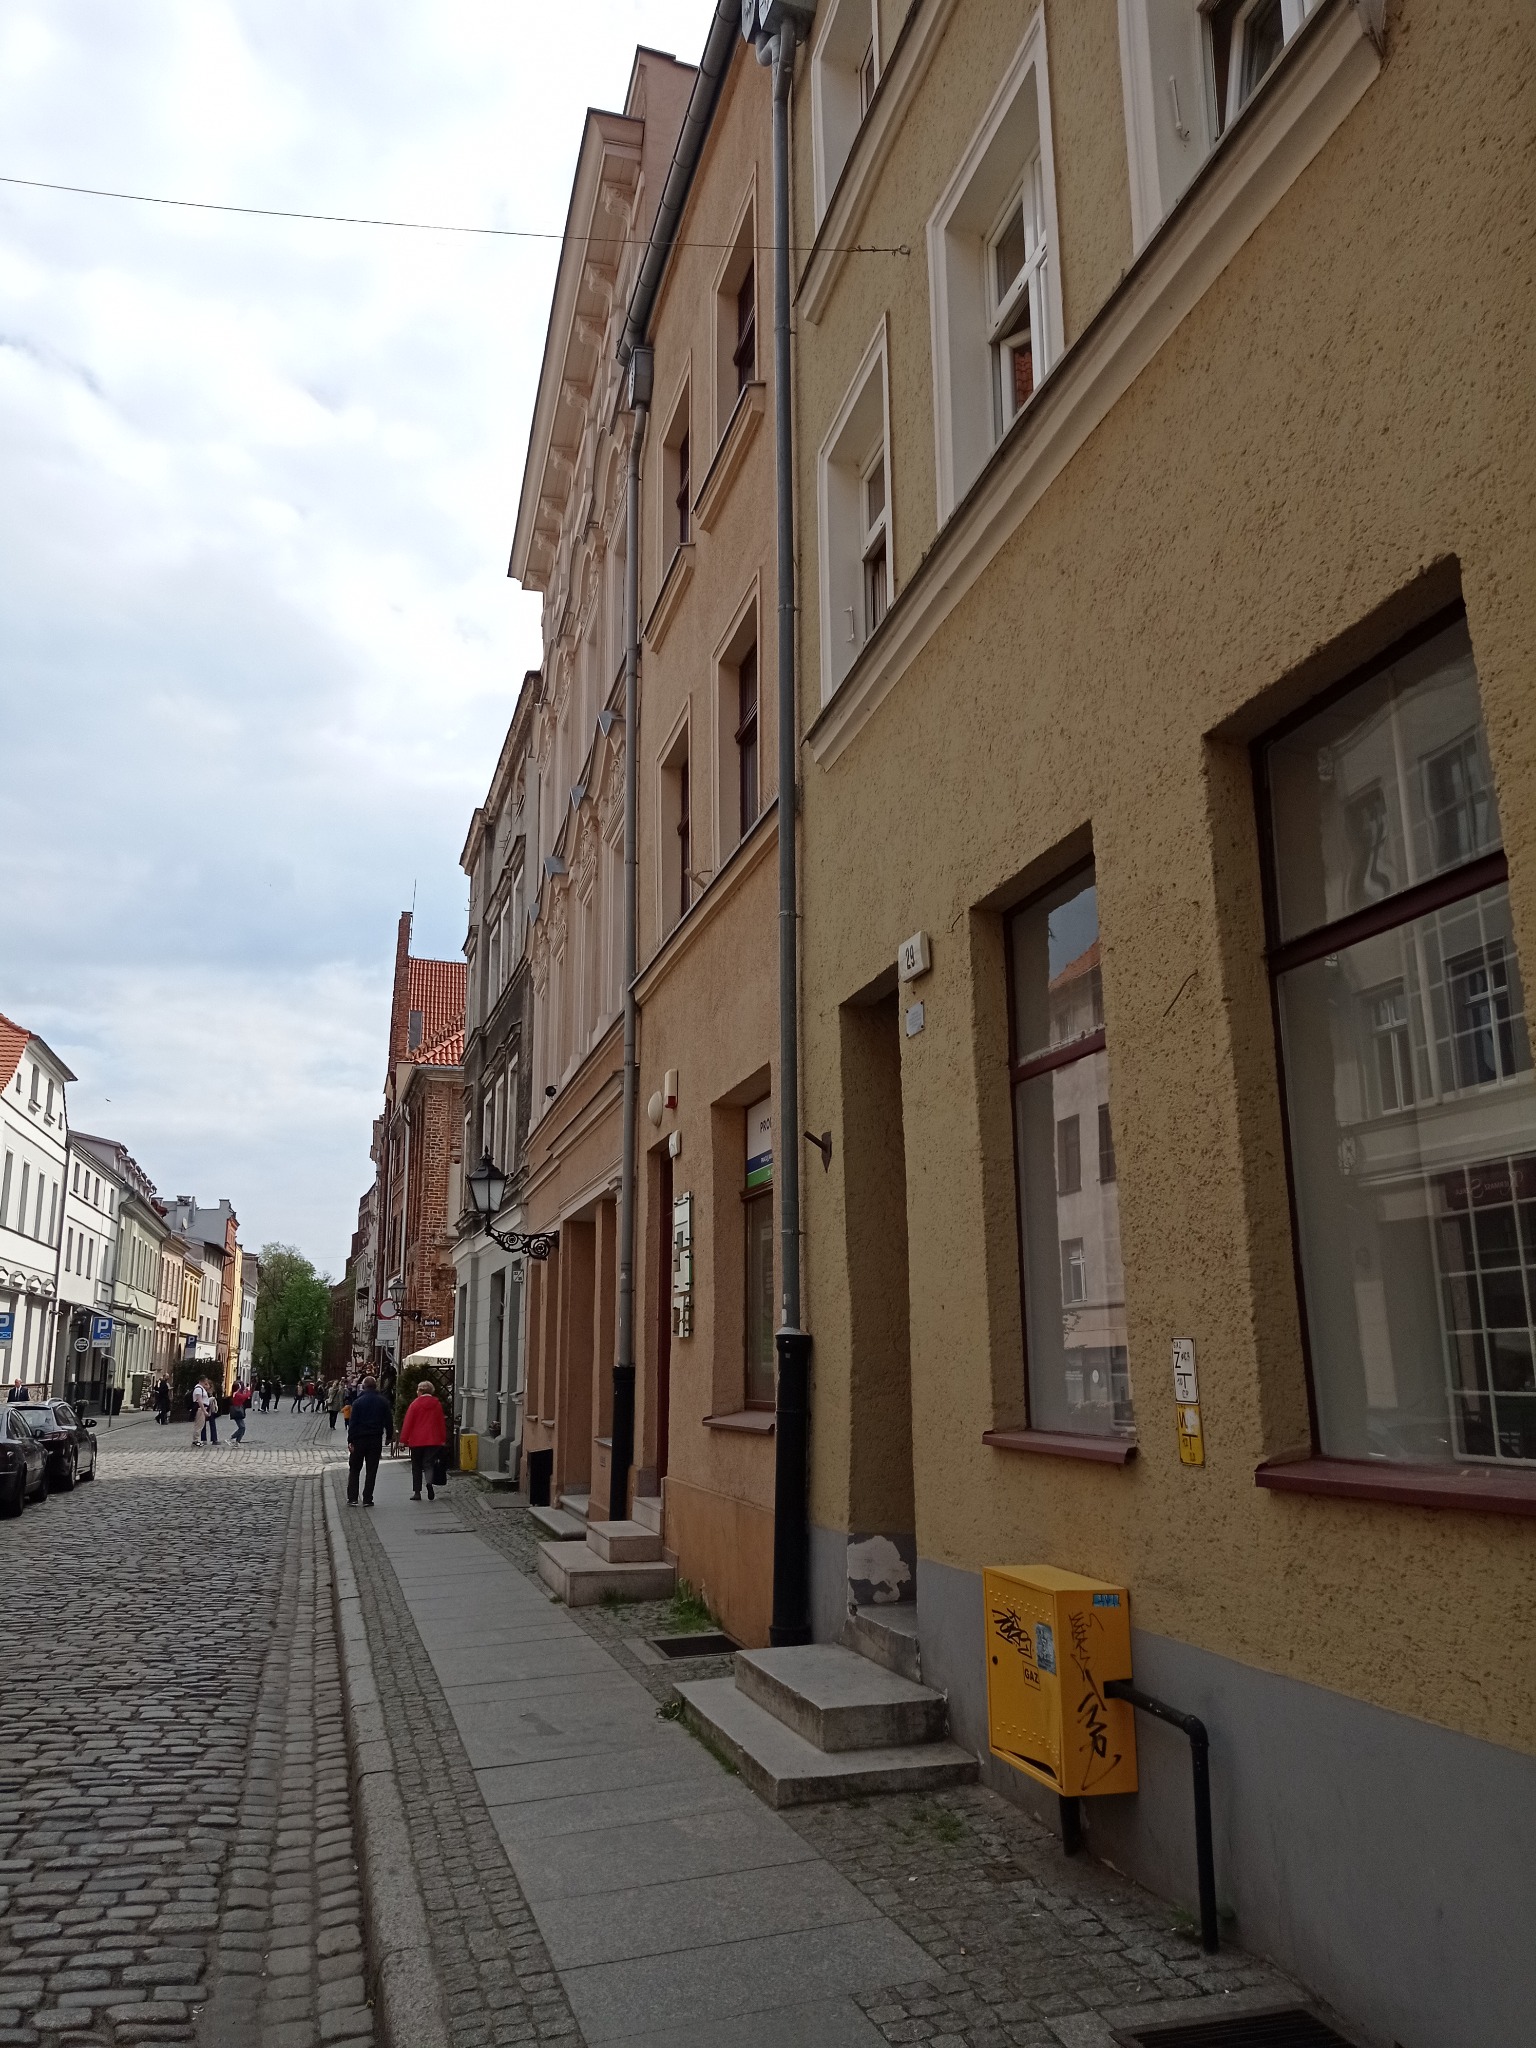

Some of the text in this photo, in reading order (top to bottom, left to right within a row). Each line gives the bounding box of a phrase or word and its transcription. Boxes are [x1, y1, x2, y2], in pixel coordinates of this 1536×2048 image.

[905, 945, 915, 970] 29
[97, 1319, 110, 1334] P
[188, 1336, 196, 1345] P
[1173, 1351, 1182, 1369] Z
[1024, 1668, 1041, 1685] GAZ
